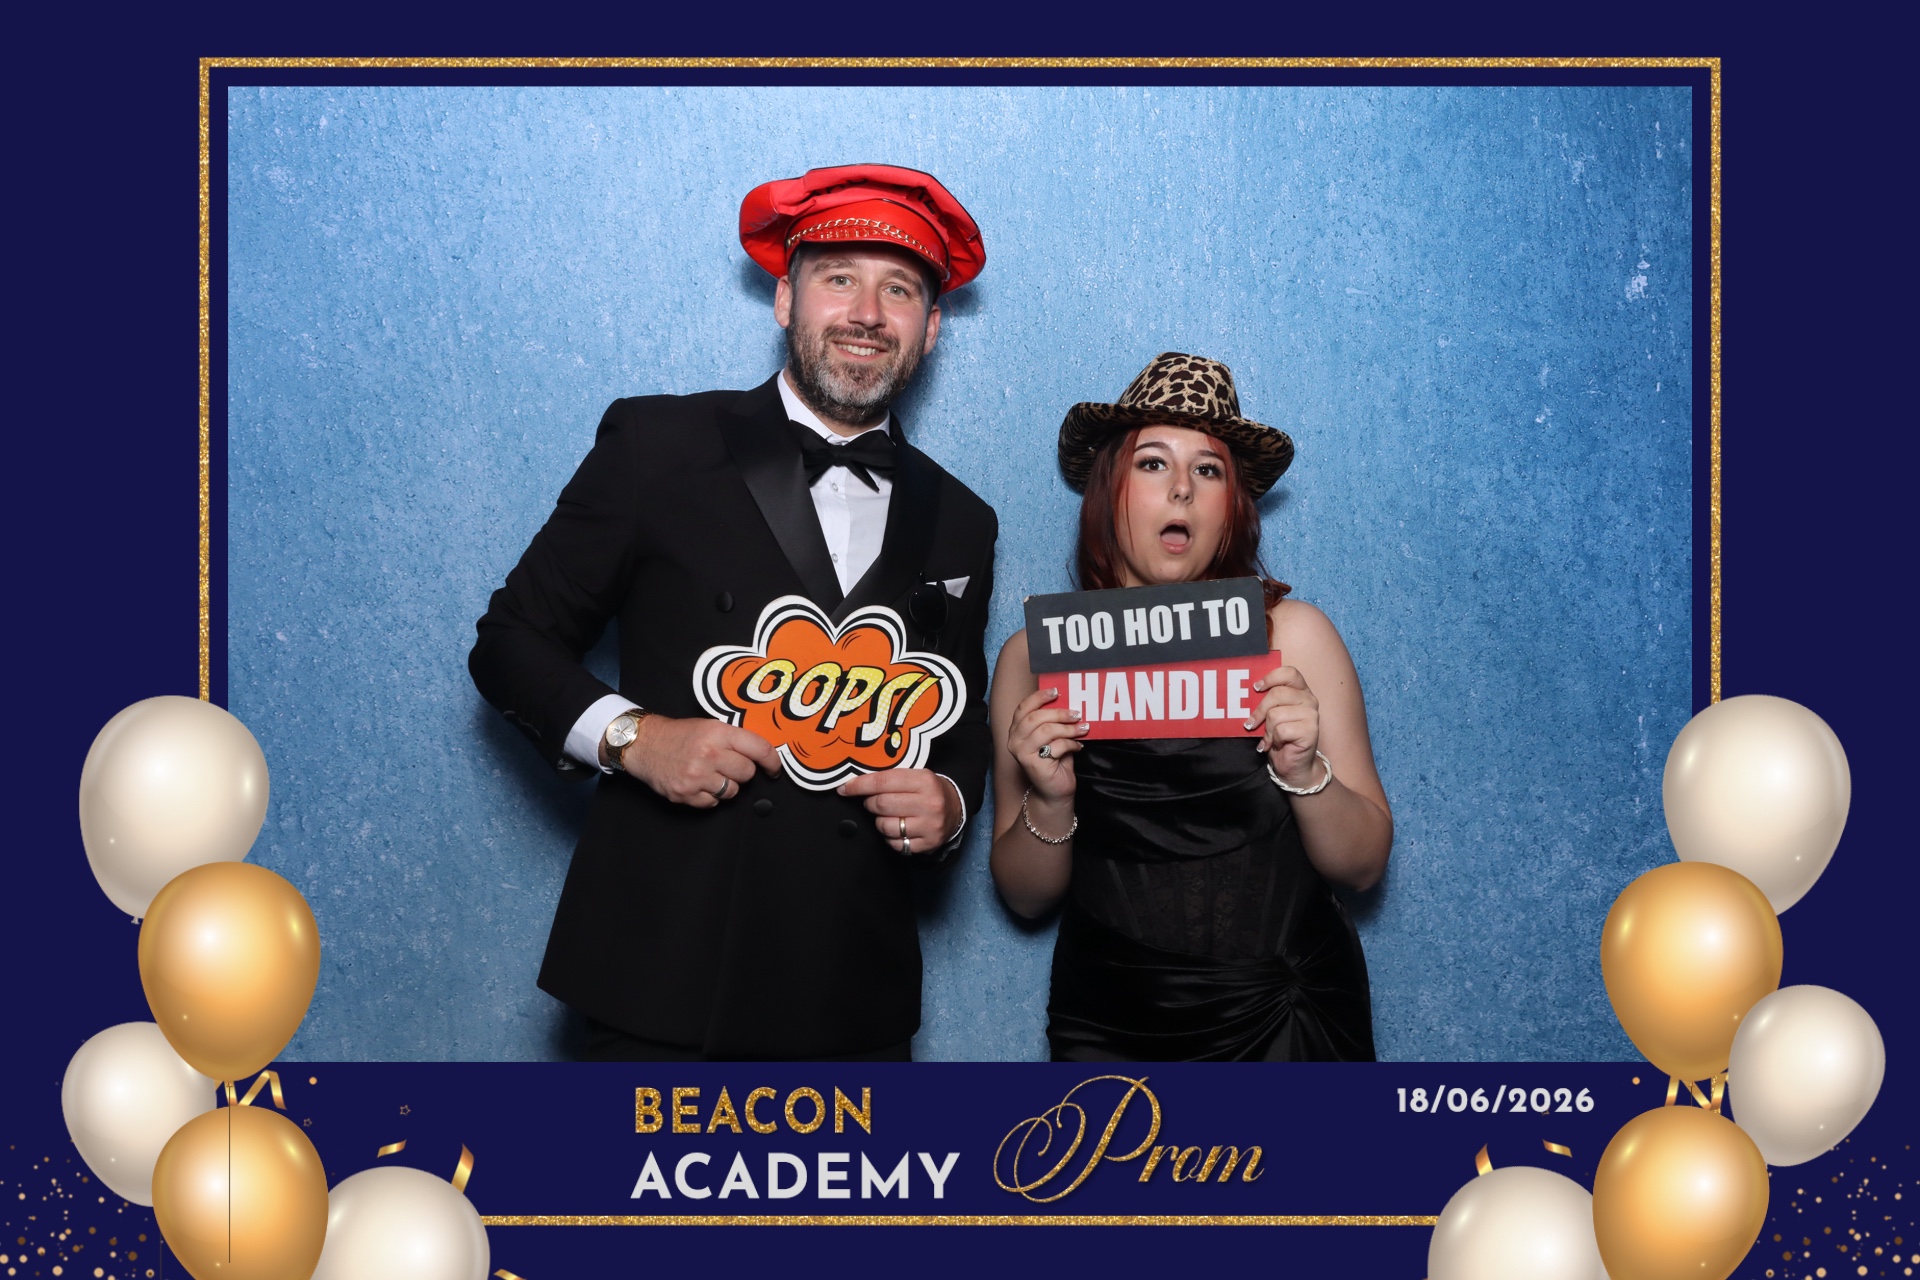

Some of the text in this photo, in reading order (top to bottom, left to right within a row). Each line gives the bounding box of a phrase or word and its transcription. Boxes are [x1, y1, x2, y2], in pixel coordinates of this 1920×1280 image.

[1042, 596, 1250, 655] TOO HOT TO
[738, 658, 942, 756] OOPS!
[1068, 668, 1251, 722] HANDLE
